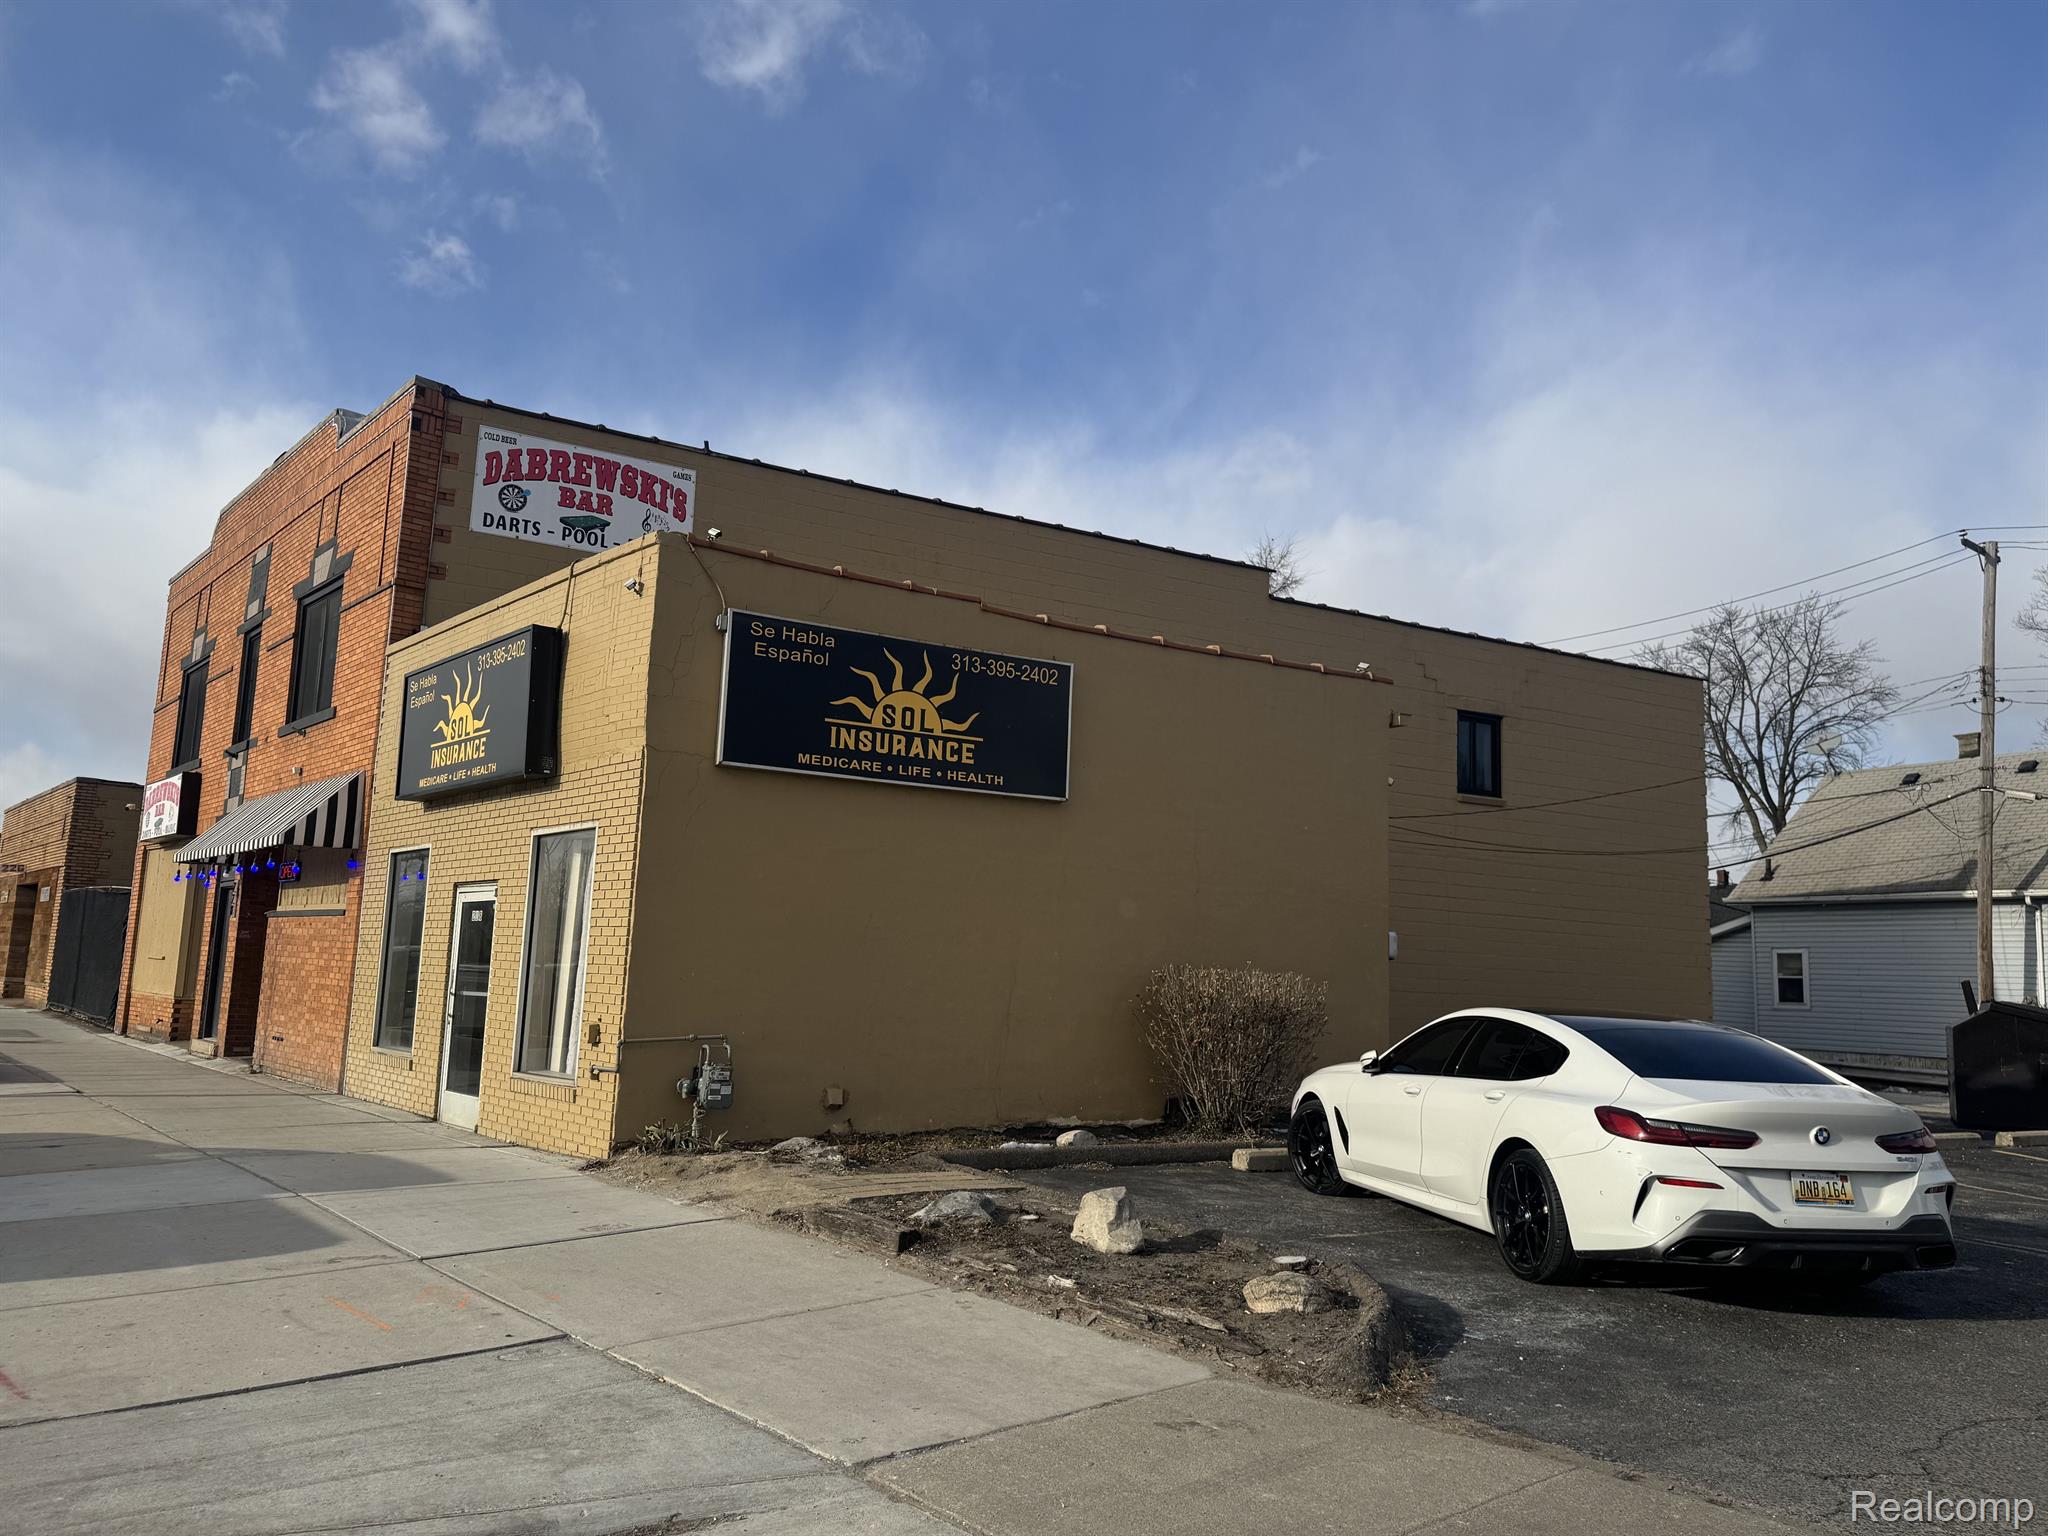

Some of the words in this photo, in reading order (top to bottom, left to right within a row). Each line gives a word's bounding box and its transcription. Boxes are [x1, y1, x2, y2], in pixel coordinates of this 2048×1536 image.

[483, 431, 500, 441] COLD
[500, 435, 517, 446] BEER
[483, 447, 688, 523] DABREWSKI'S
[672, 471, 692, 482] GAMES
[558, 486, 613, 516] BAR
[483, 512, 541, 547] DARTS
[561, 527, 609, 549] POOL
[750, 621, 775, 638] Se
[782, 626, 836, 648] Habla
[477, 639, 526, 672] 313-395-2402
[754, 641, 830, 667] Español
[410, 680, 419, 693] Se
[419, 673, 437, 689] Habla
[951, 653, 1059, 686] 313-395-2402
[410, 690, 435, 709] Español
[450, 715, 471, 740] SOL
[881, 703, 935, 732] SOL
[430, 737, 487, 769] INSURANCE
[830, 726, 975, 764] INSURANCE
[418, 772, 448, 788] MEDICARE
[453, 769, 466, 781] LIFE
[471, 762, 497, 776] HEALTH
[797, 752, 882, 773] MEDICARE
[898, 764, 932, 778] LIFE
[947, 769, 1004, 786] HEALTH
